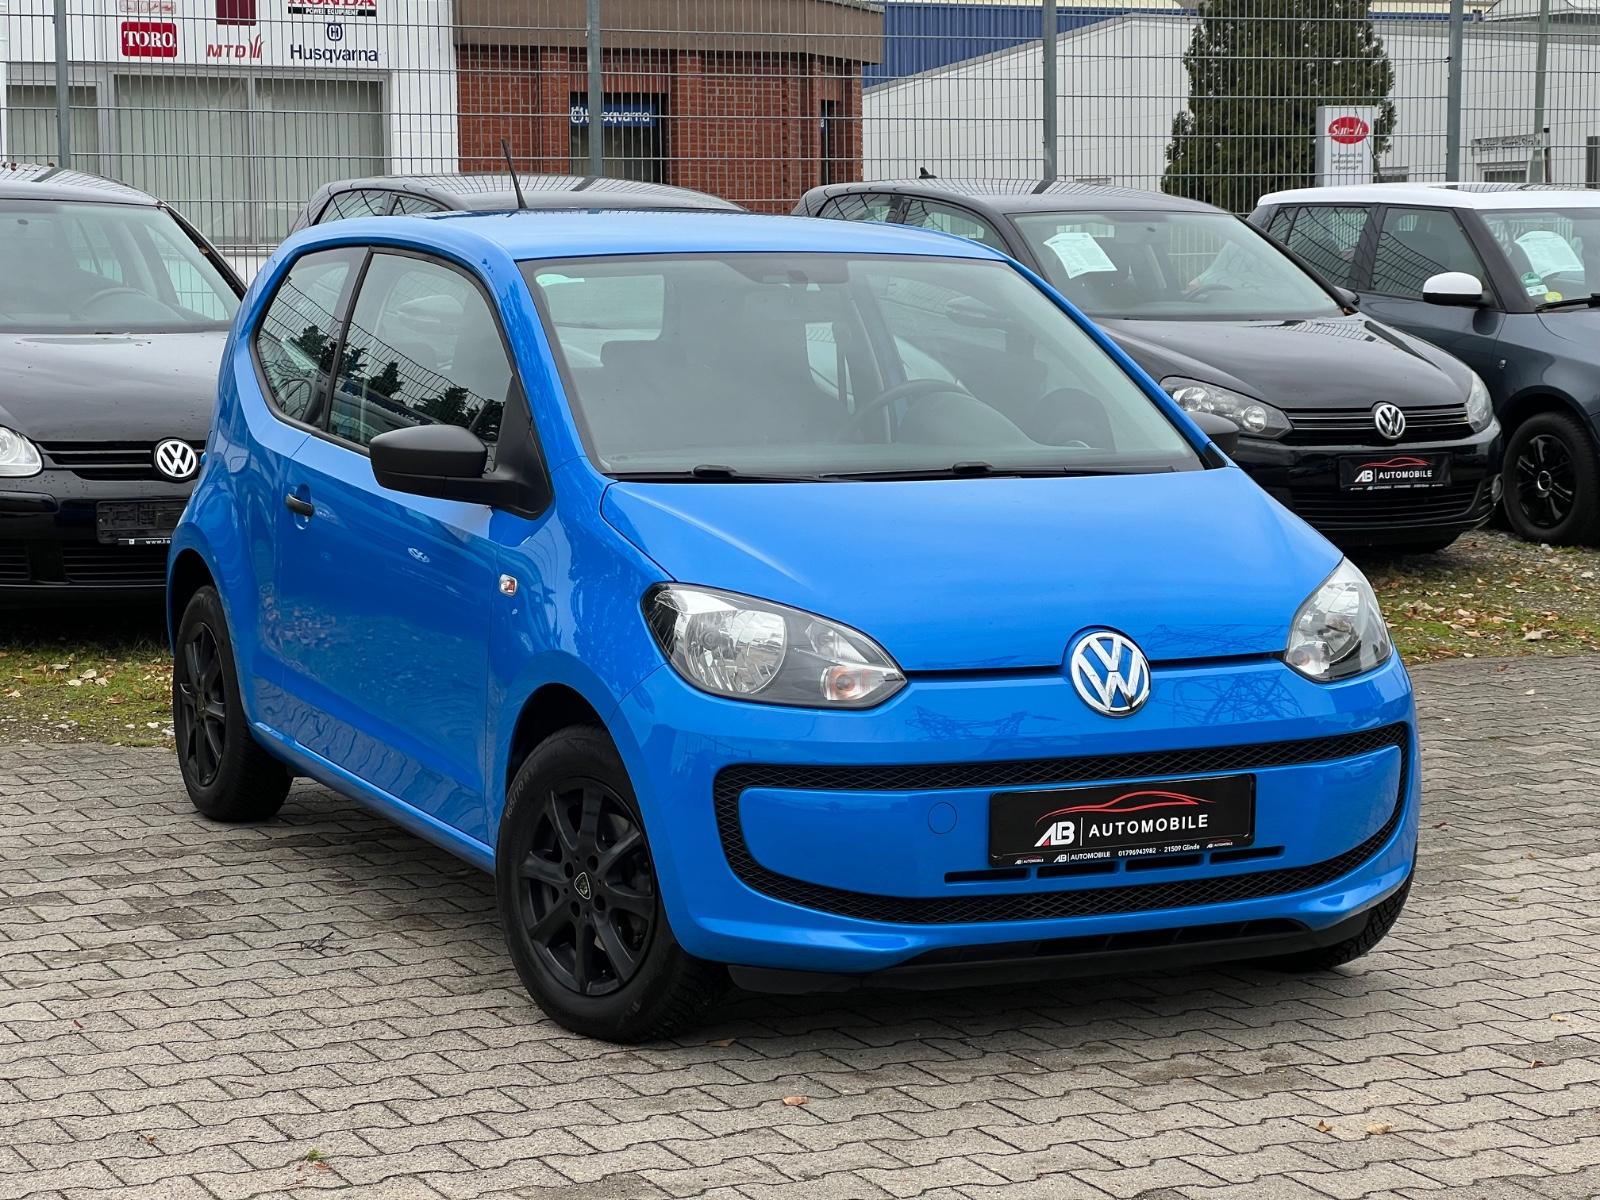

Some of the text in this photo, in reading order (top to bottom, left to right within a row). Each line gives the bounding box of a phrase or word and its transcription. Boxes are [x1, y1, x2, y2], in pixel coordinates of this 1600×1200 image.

[207, 44, 246, 58] MTD
[290, 44, 378, 63] Husqvarna
[1378, 470, 1432, 479] AUTOMOBILE
[1034, 814, 1209, 848] AB AUTOMOBILE
[1070, 851, 1111, 861] AUTOMOBILE
[1182, 843, 1200, 851] Glinde
